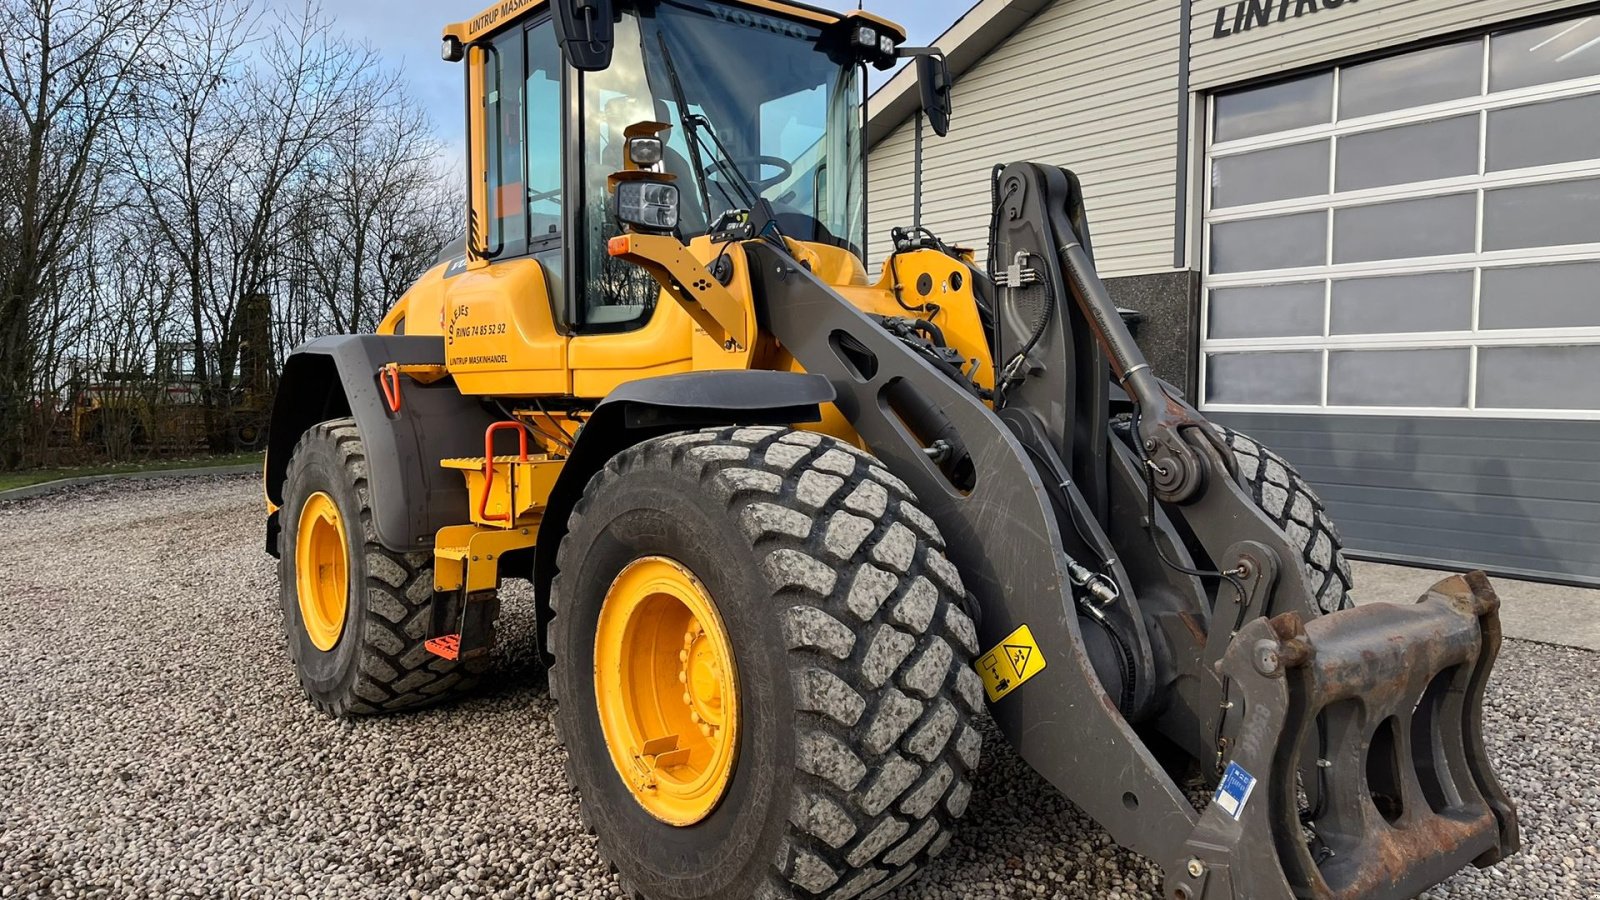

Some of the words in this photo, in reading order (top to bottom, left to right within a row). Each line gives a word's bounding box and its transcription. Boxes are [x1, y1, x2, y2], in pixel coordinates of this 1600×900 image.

[469, 8, 499, 35] LINTRUP
[500, 0, 532, 18] MASK
[703, 3, 808, 41] VOLVO
[1213, 0, 1359, 39] LINTR
[448, 304, 469, 345] UDLEJES
[456, 326, 471, 338] RING
[471, 325, 479, 336] 74
[479, 324, 487, 336] 85
[488, 324, 496, 335] 52
[497, 323, 506, 334] 92
[449, 357, 468, 366] LINTRUP
[468, 354, 508, 365] MASKINHANDEL
